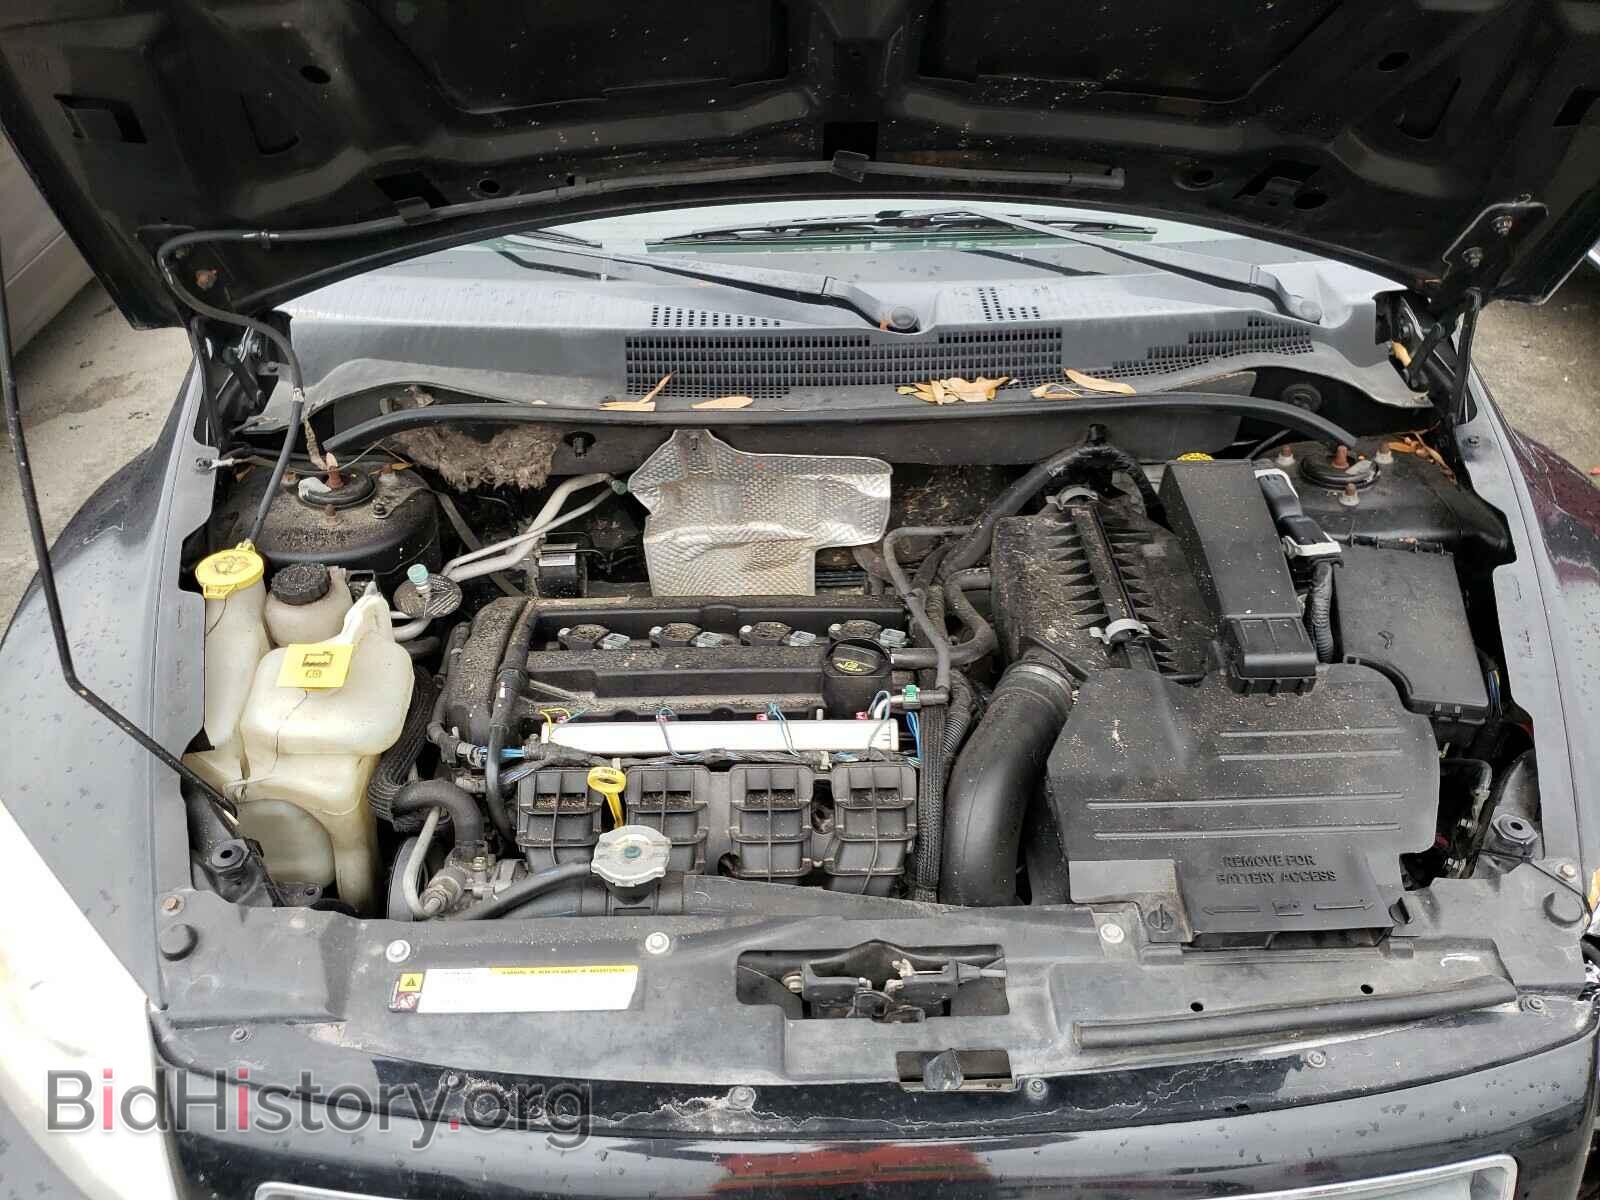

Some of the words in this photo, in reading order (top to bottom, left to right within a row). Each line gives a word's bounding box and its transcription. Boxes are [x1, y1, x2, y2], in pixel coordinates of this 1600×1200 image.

[1222, 855, 1284, 868] REMOVE
[1285, 854, 1317, 866] FOR
[1215, 871, 1275, 885] BATTERY
[1280, 870, 1337, 883] ACCESS
